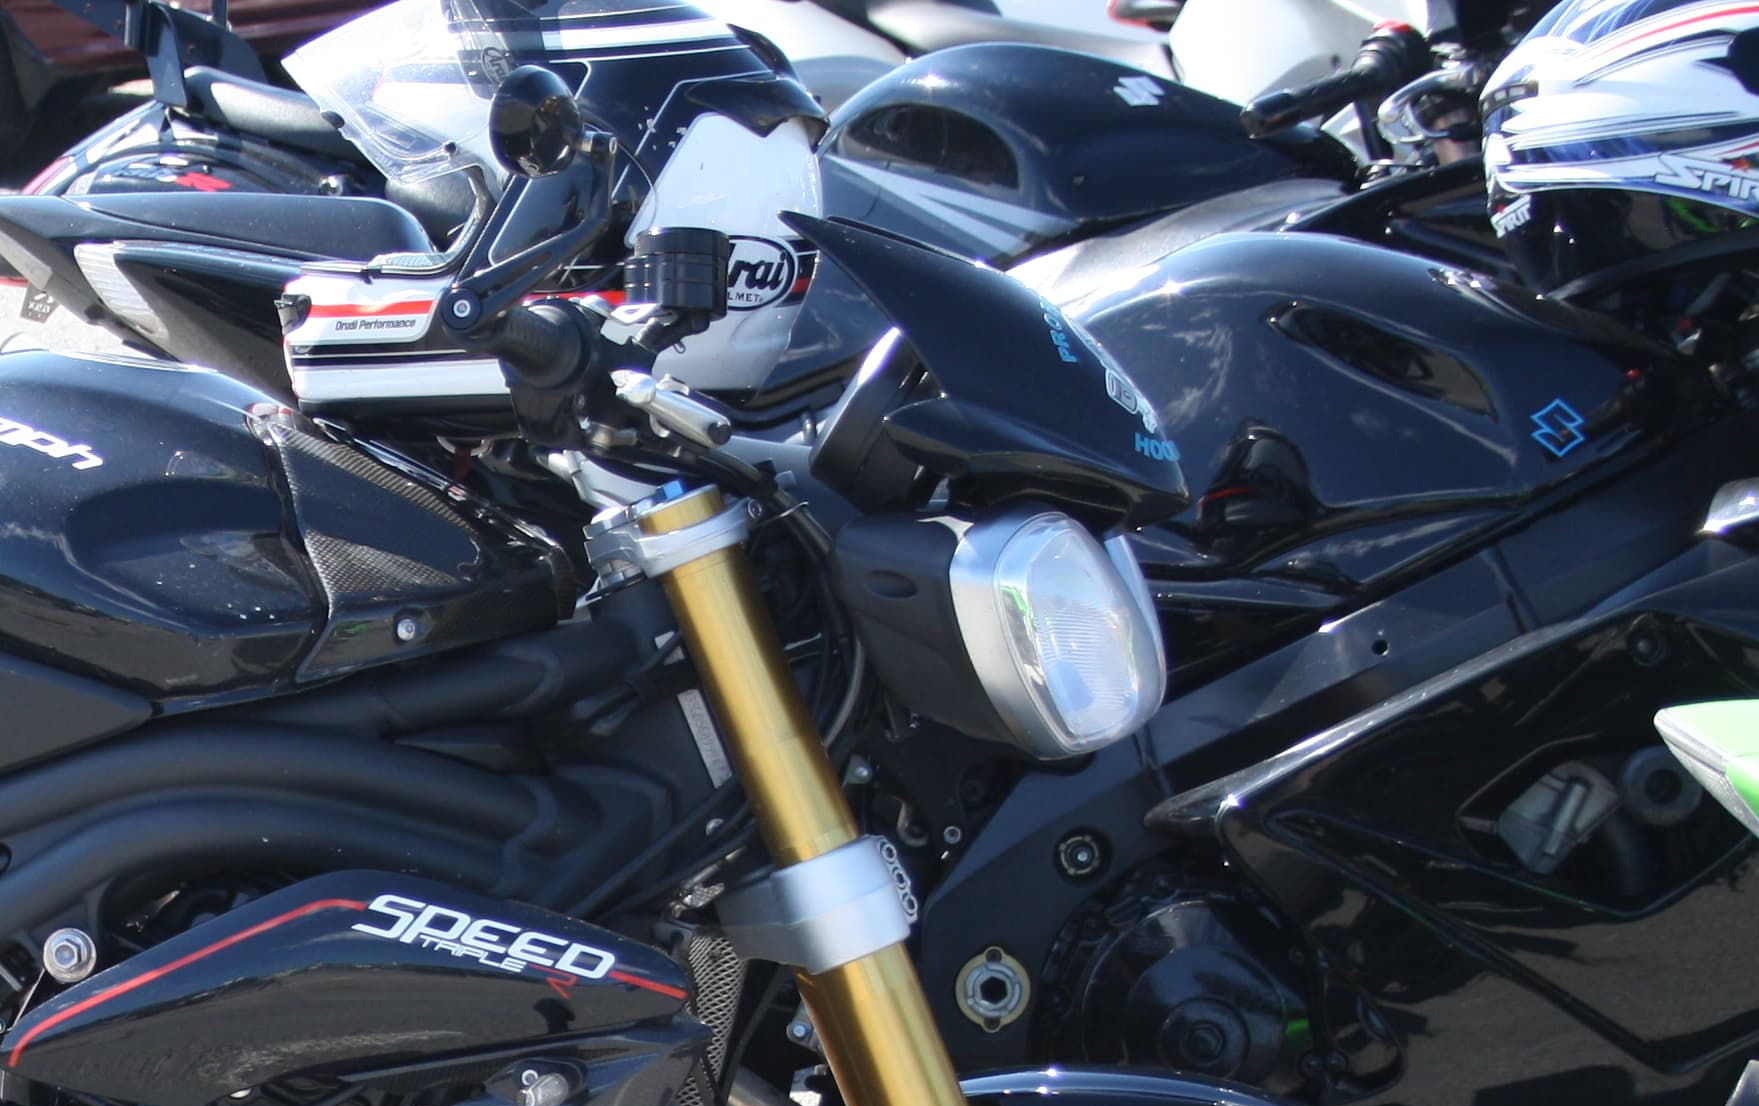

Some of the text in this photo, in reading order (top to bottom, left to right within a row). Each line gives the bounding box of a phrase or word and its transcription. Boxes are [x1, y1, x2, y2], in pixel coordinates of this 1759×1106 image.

[726, 242, 787, 290] rai
[727, 291, 761, 303] LMET
[358, 318, 416, 331] Performance
[351, 894, 615, 979] SPEED
[420, 934, 528, 973] TRIPLE
